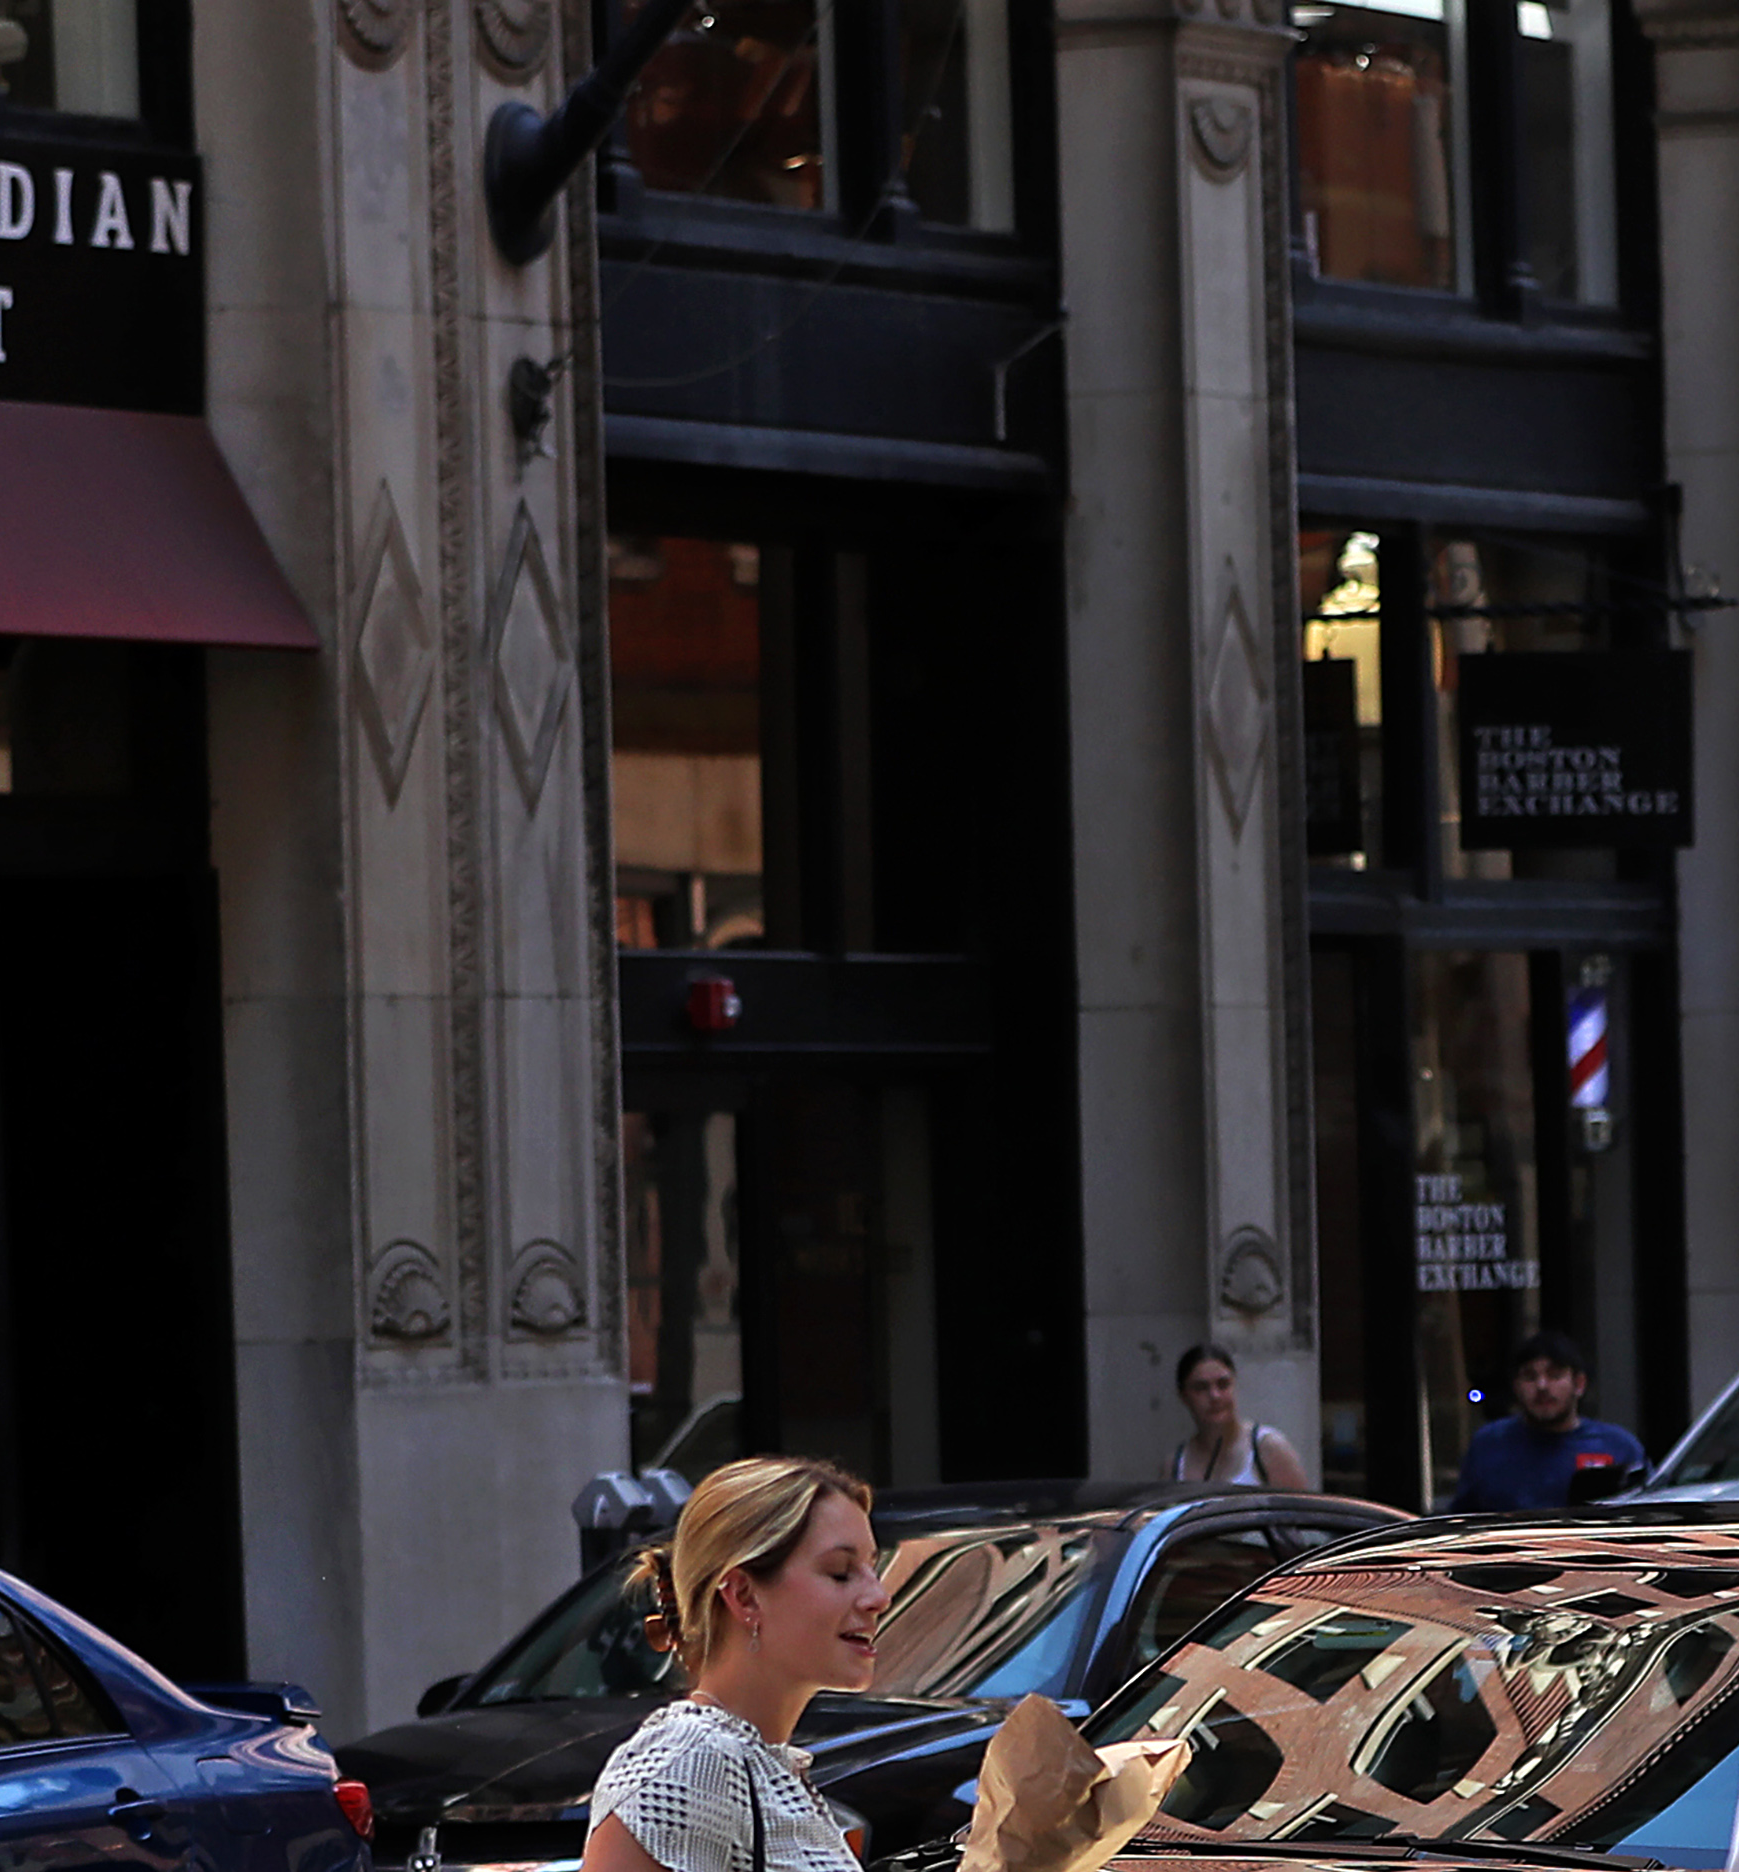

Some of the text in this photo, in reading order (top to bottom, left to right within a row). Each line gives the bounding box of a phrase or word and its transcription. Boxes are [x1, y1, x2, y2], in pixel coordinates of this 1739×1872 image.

[1473, 725, 1553, 748] THE
[1476, 747, 1622, 771] BOSTON
[1477, 772, 1623, 794] BARBER
[1477, 790, 1679, 816] EXCHANGE
[1414, 1174, 1462, 1203] THE
[1416, 1204, 1505, 1231] BOSTON
[1417, 1233, 1507, 1261] BARBER
[1417, 1261, 1541, 1291] EXCHANGE
